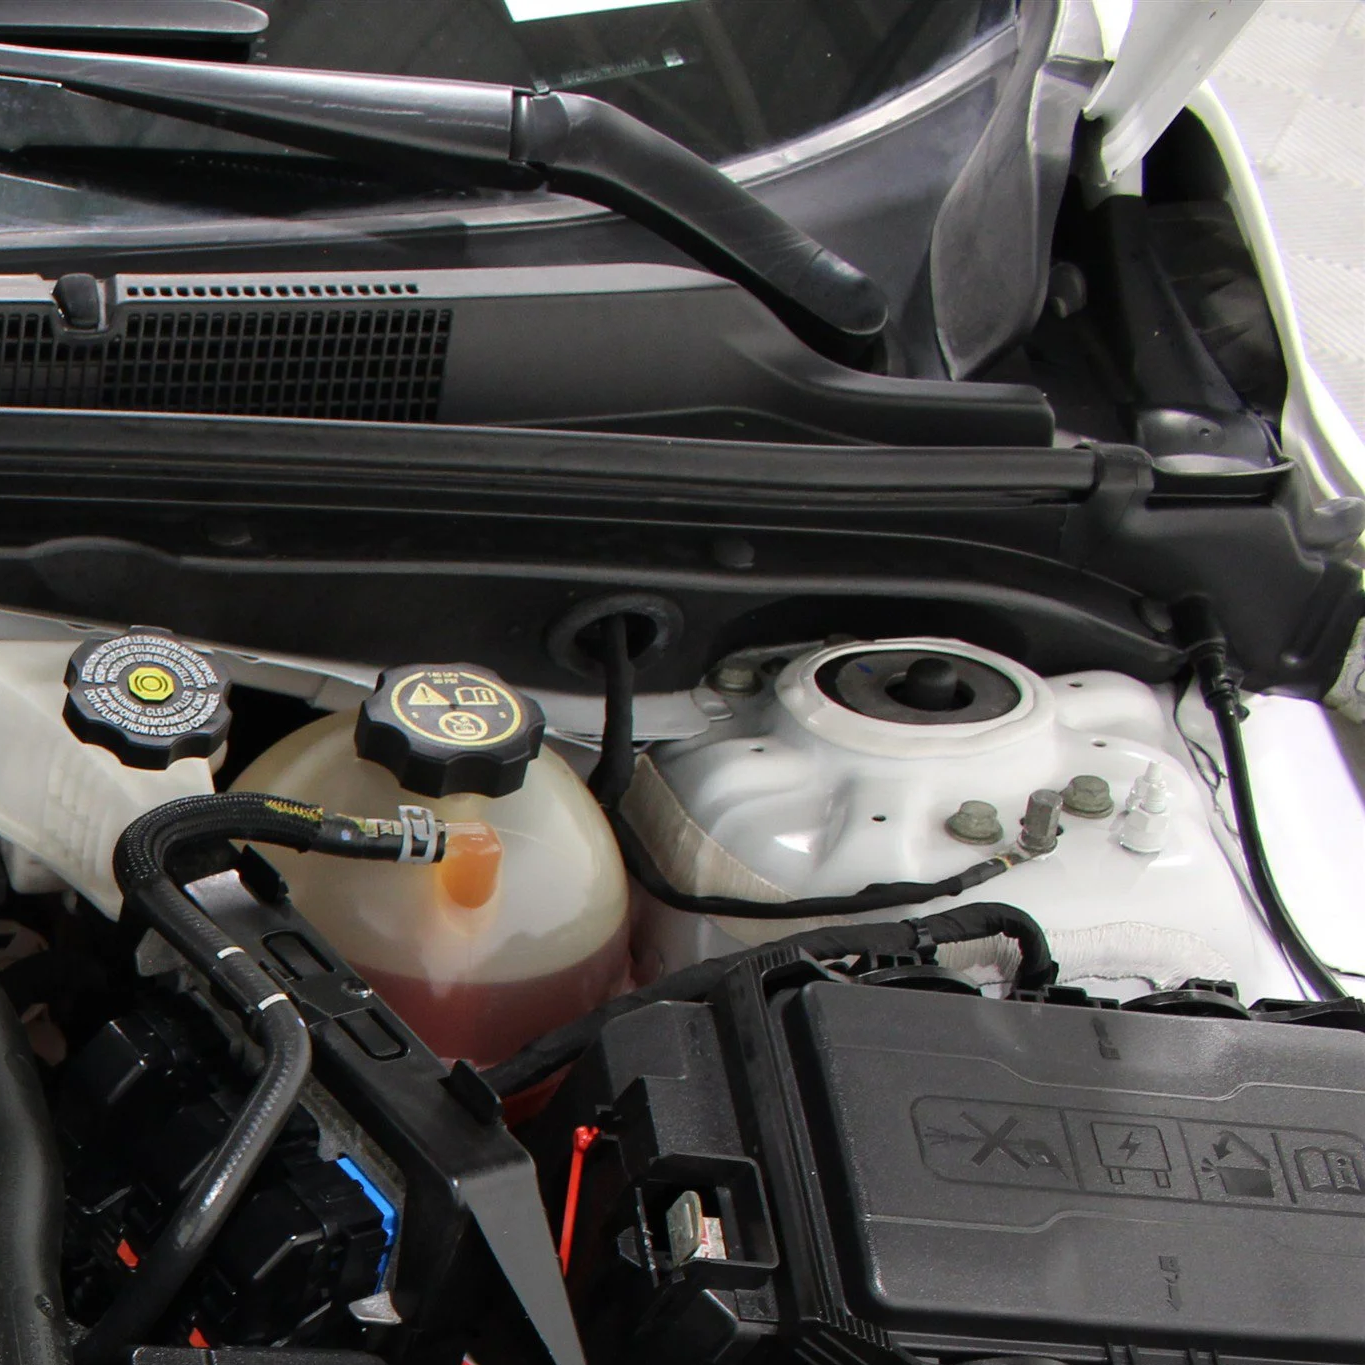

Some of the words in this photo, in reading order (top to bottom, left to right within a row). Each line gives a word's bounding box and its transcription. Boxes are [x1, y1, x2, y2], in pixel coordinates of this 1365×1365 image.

[106, 700, 139, 723] BEFORE
[145, 706, 176, 717] CLEAN
[173, 690, 194, 711] FILLER
[97, 706, 123, 724] FLUID
[121, 720, 149, 735] FROM
[157, 722, 192, 736] SEALED
